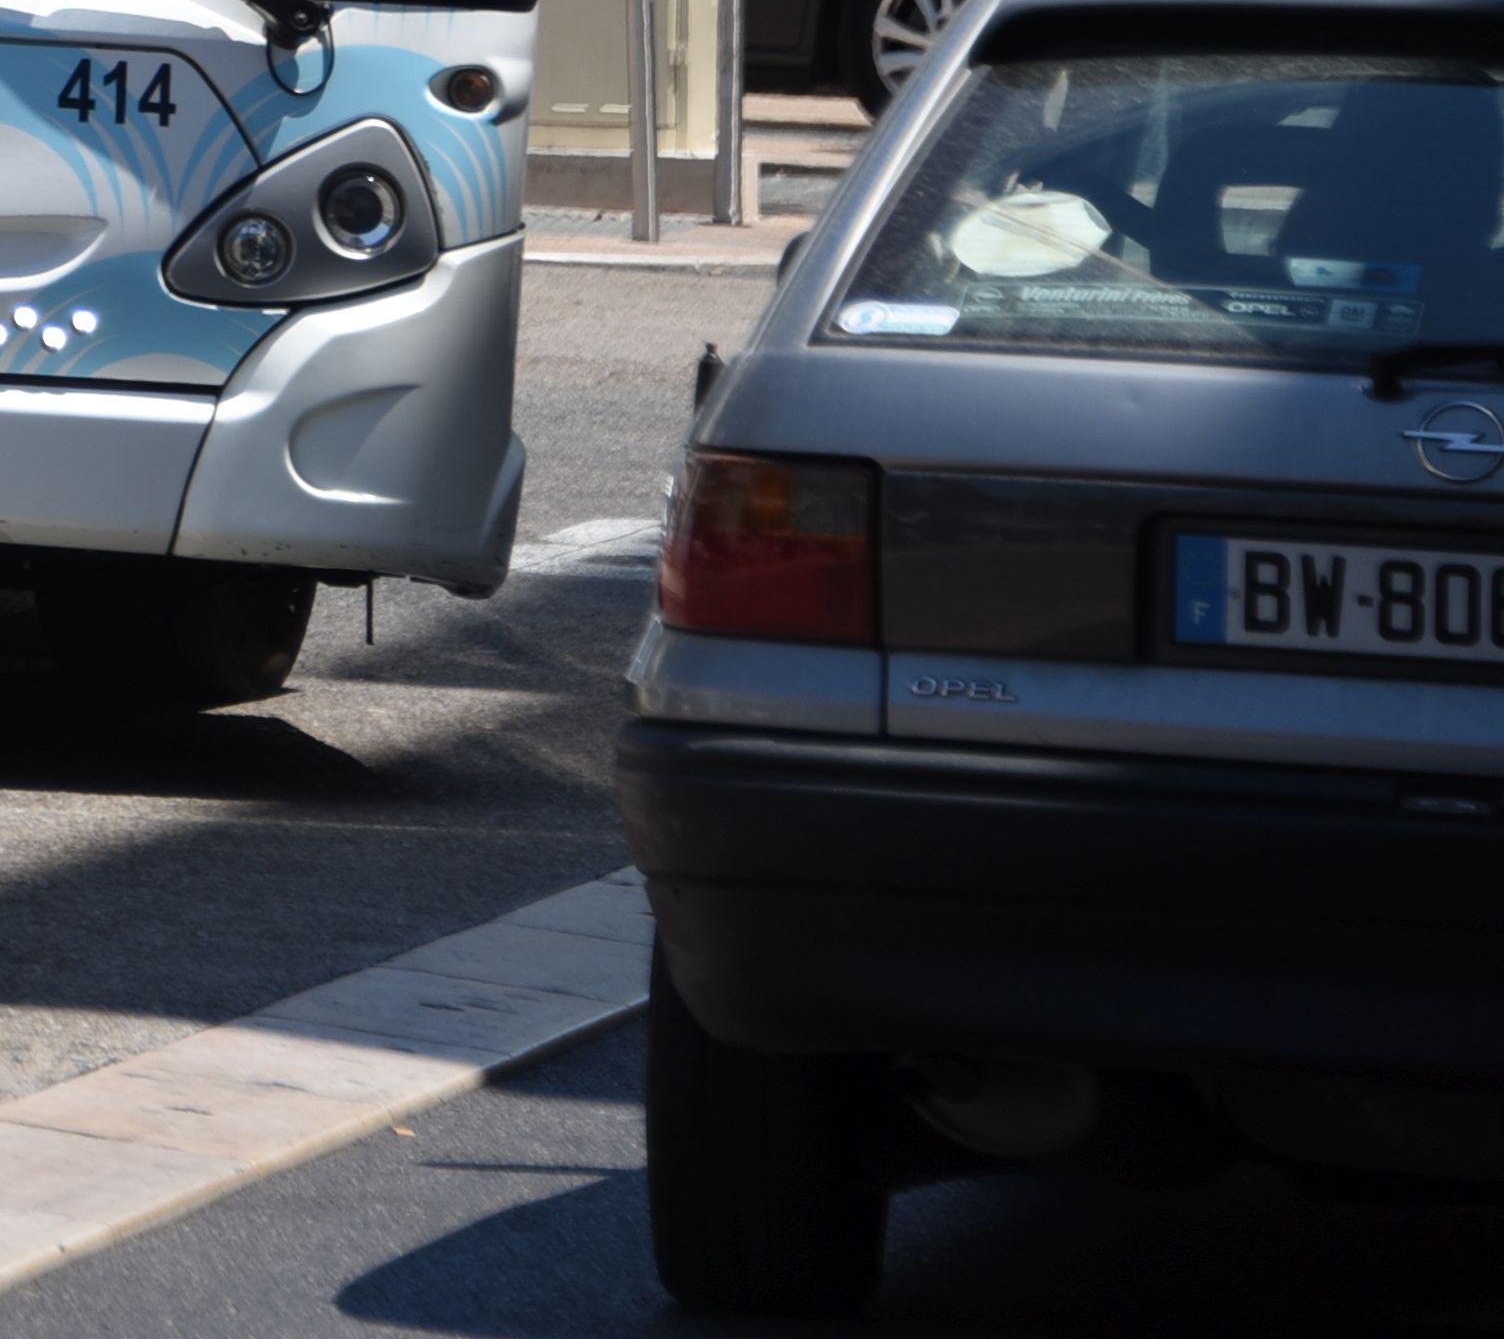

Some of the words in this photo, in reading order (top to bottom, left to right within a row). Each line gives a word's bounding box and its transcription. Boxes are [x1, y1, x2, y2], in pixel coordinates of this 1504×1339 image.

[58, 58, 177, 127] 414
[1225, 300, 1297, 317] OPEL
[1192, 601, 1211, 627] F
[1243, 550, 1504, 650] BW-80
[910, 676, 1017, 702] OPEL
